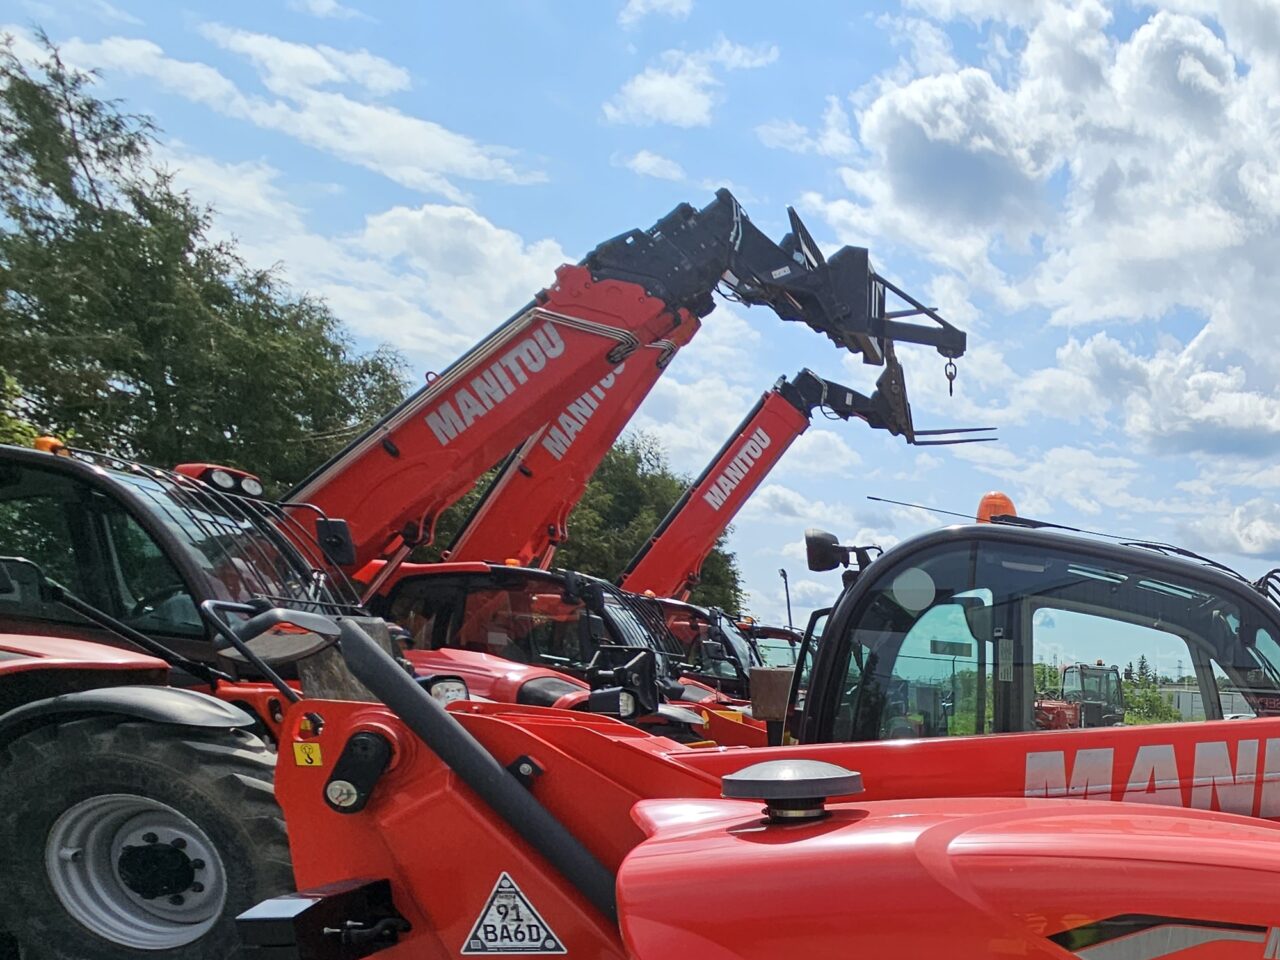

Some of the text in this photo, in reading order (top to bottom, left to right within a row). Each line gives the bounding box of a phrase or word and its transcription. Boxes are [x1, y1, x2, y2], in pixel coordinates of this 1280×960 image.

[425, 321, 567, 447] MANITOU
[703, 426, 772, 511] MANITOU
[483, 924, 541, 943] BA6D
[496, 904, 524, 923] 91
